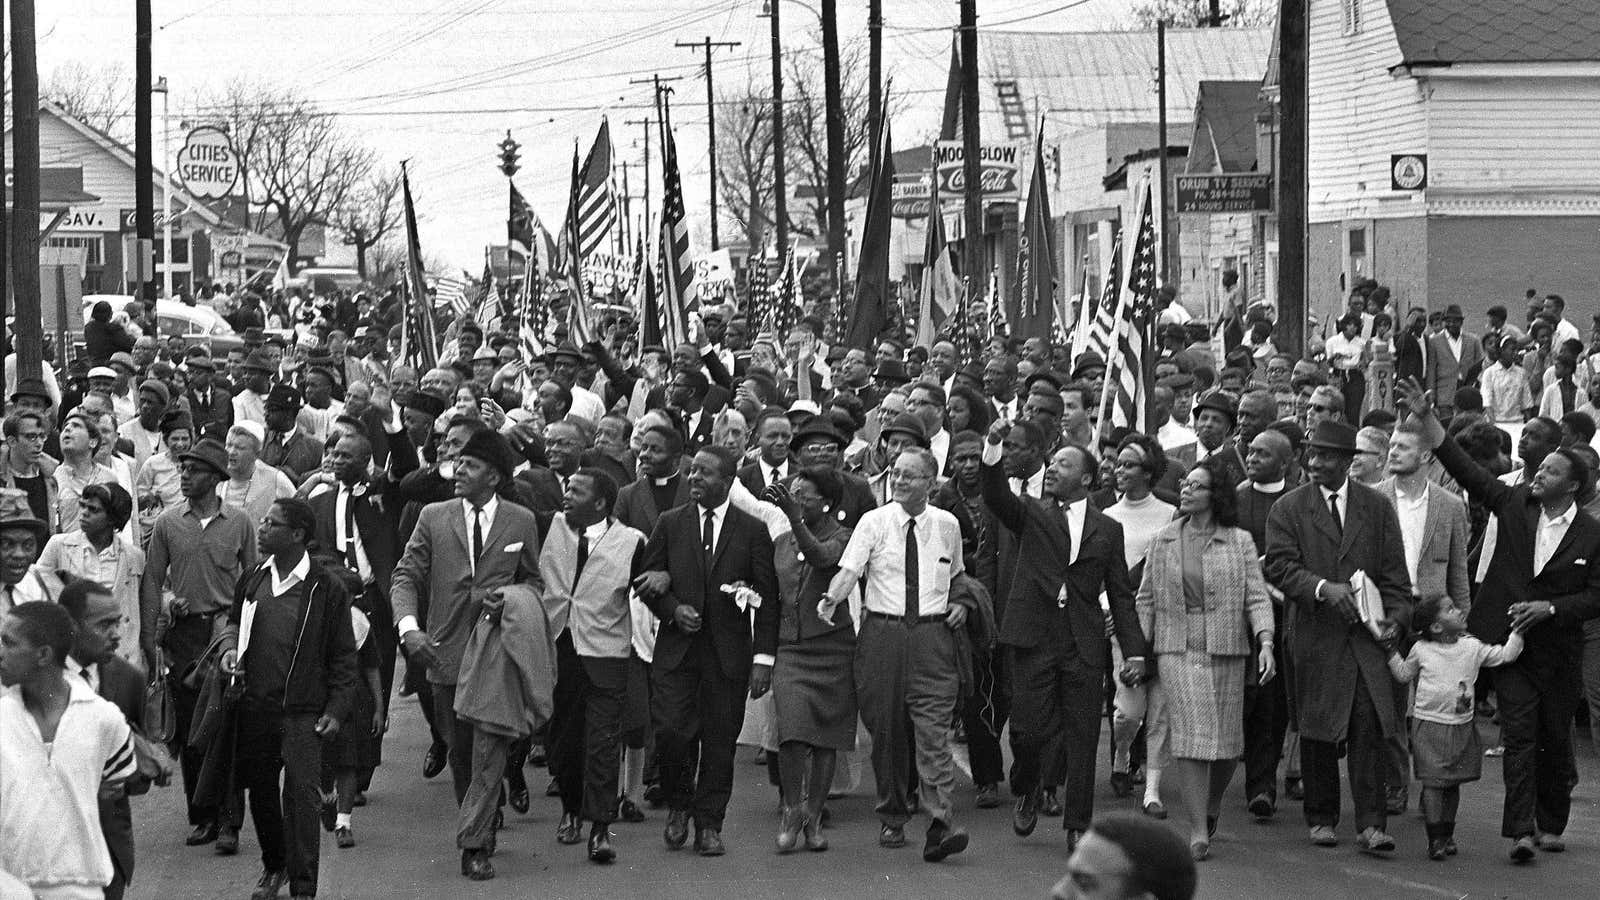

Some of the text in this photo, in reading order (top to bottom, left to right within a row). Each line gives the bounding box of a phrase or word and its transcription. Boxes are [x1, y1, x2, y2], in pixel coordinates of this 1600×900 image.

[190, 144, 229, 161] CITIES
[936, 146, 1017, 164] MOOGLOW
[183, 165, 233, 182] SERVICE
[1214, 178, 1228, 189] TV
[1184, 201, 1196, 211] 24
